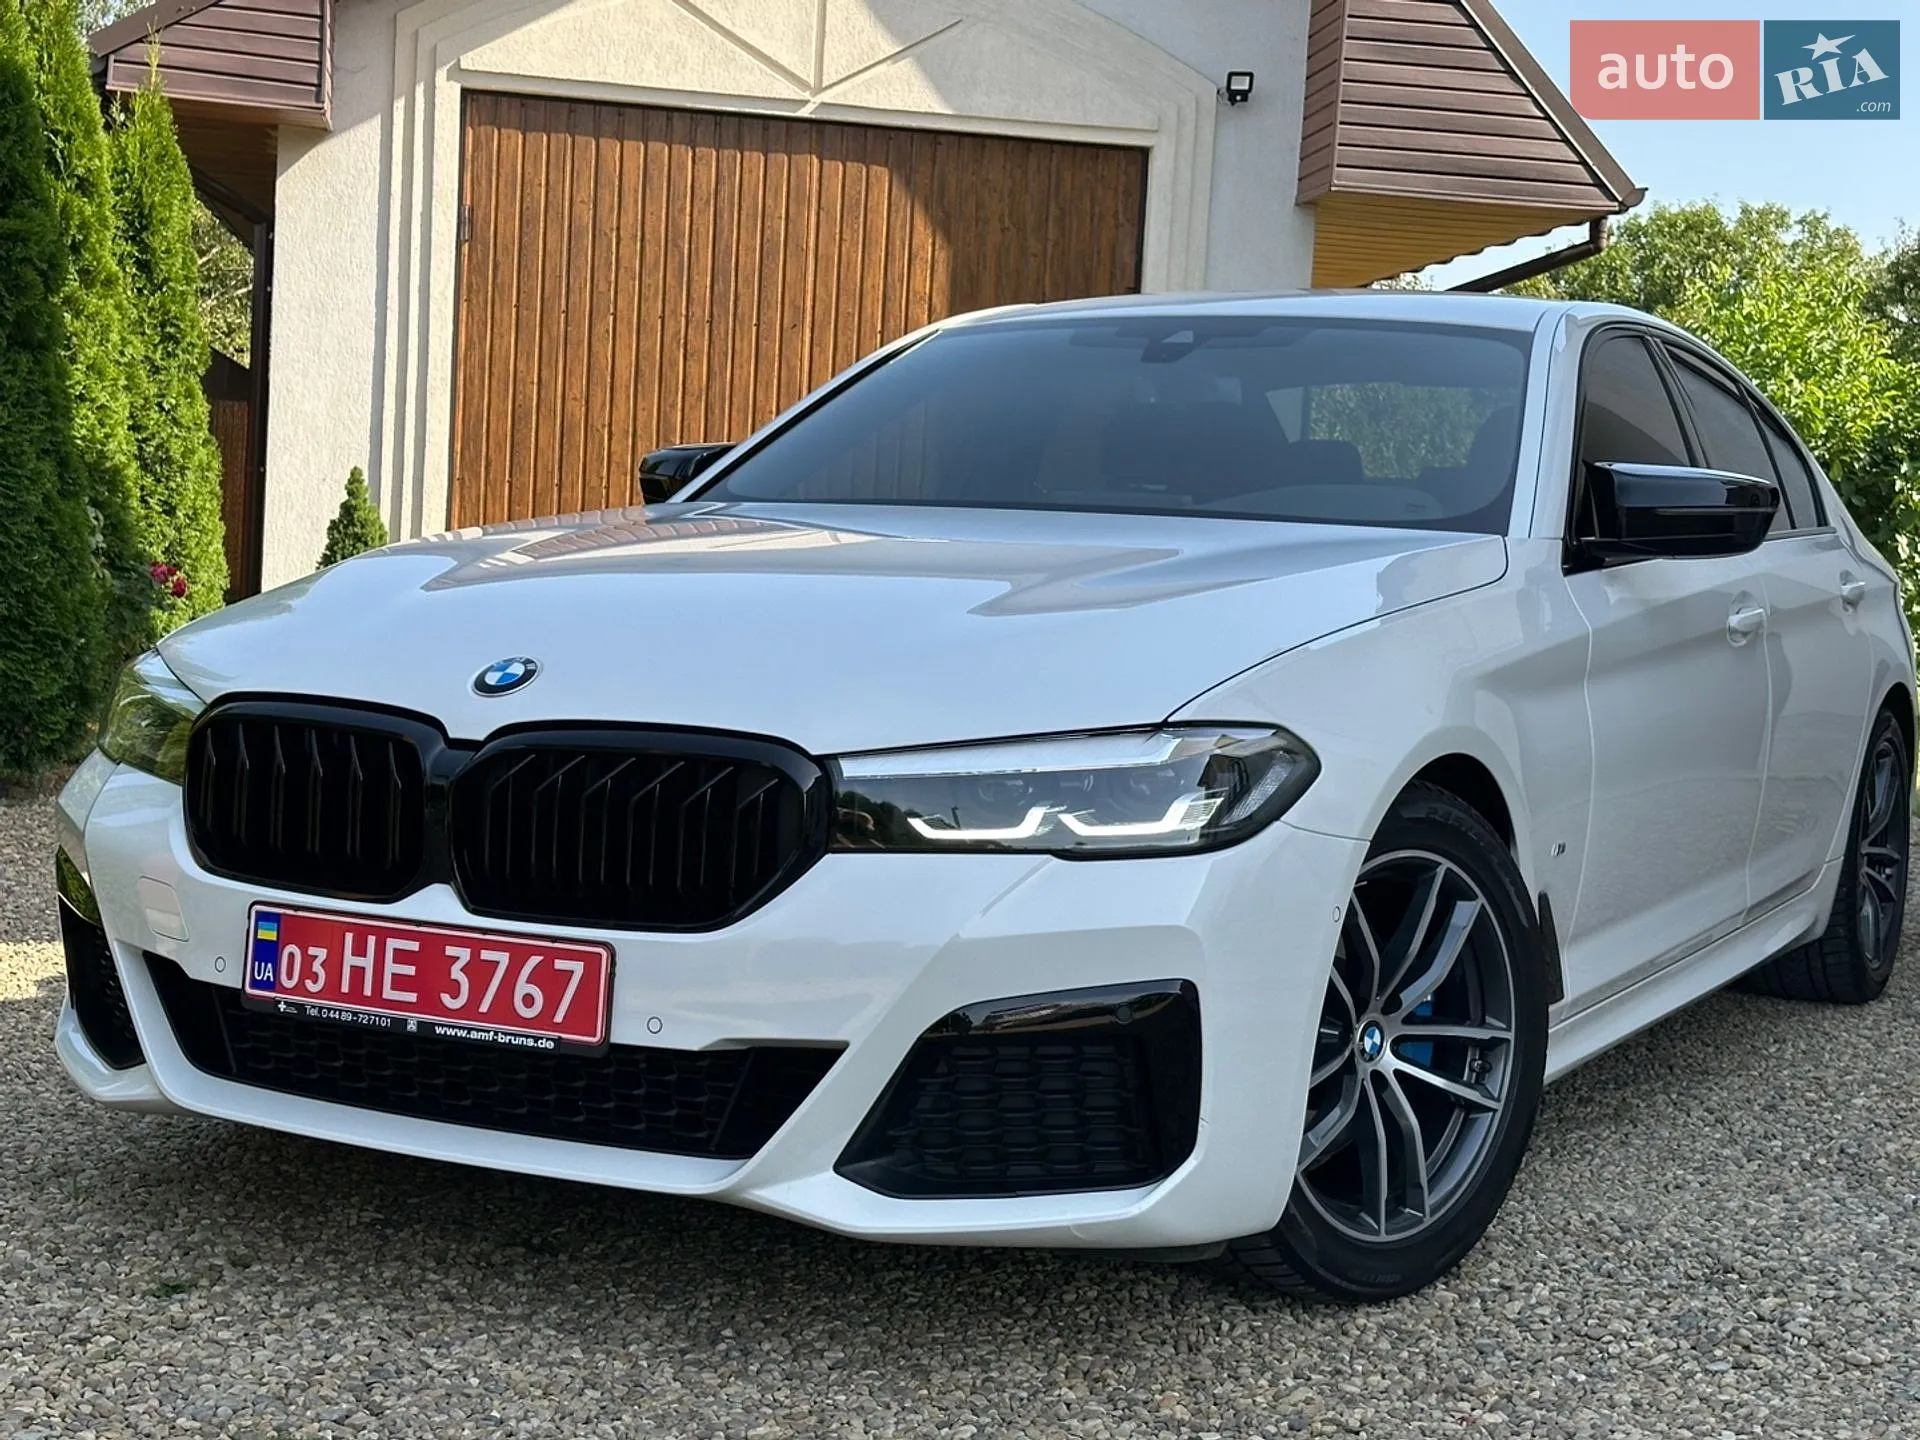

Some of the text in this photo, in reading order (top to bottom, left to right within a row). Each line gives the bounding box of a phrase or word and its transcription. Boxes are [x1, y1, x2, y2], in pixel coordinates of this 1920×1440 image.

[254, 961, 274, 982] UA
[279, 932, 585, 1024] 03 HE 3767
[304, 1005, 320, 1017] Tel.
[434, 1025, 555, 1050] www.amf-bruns.de
